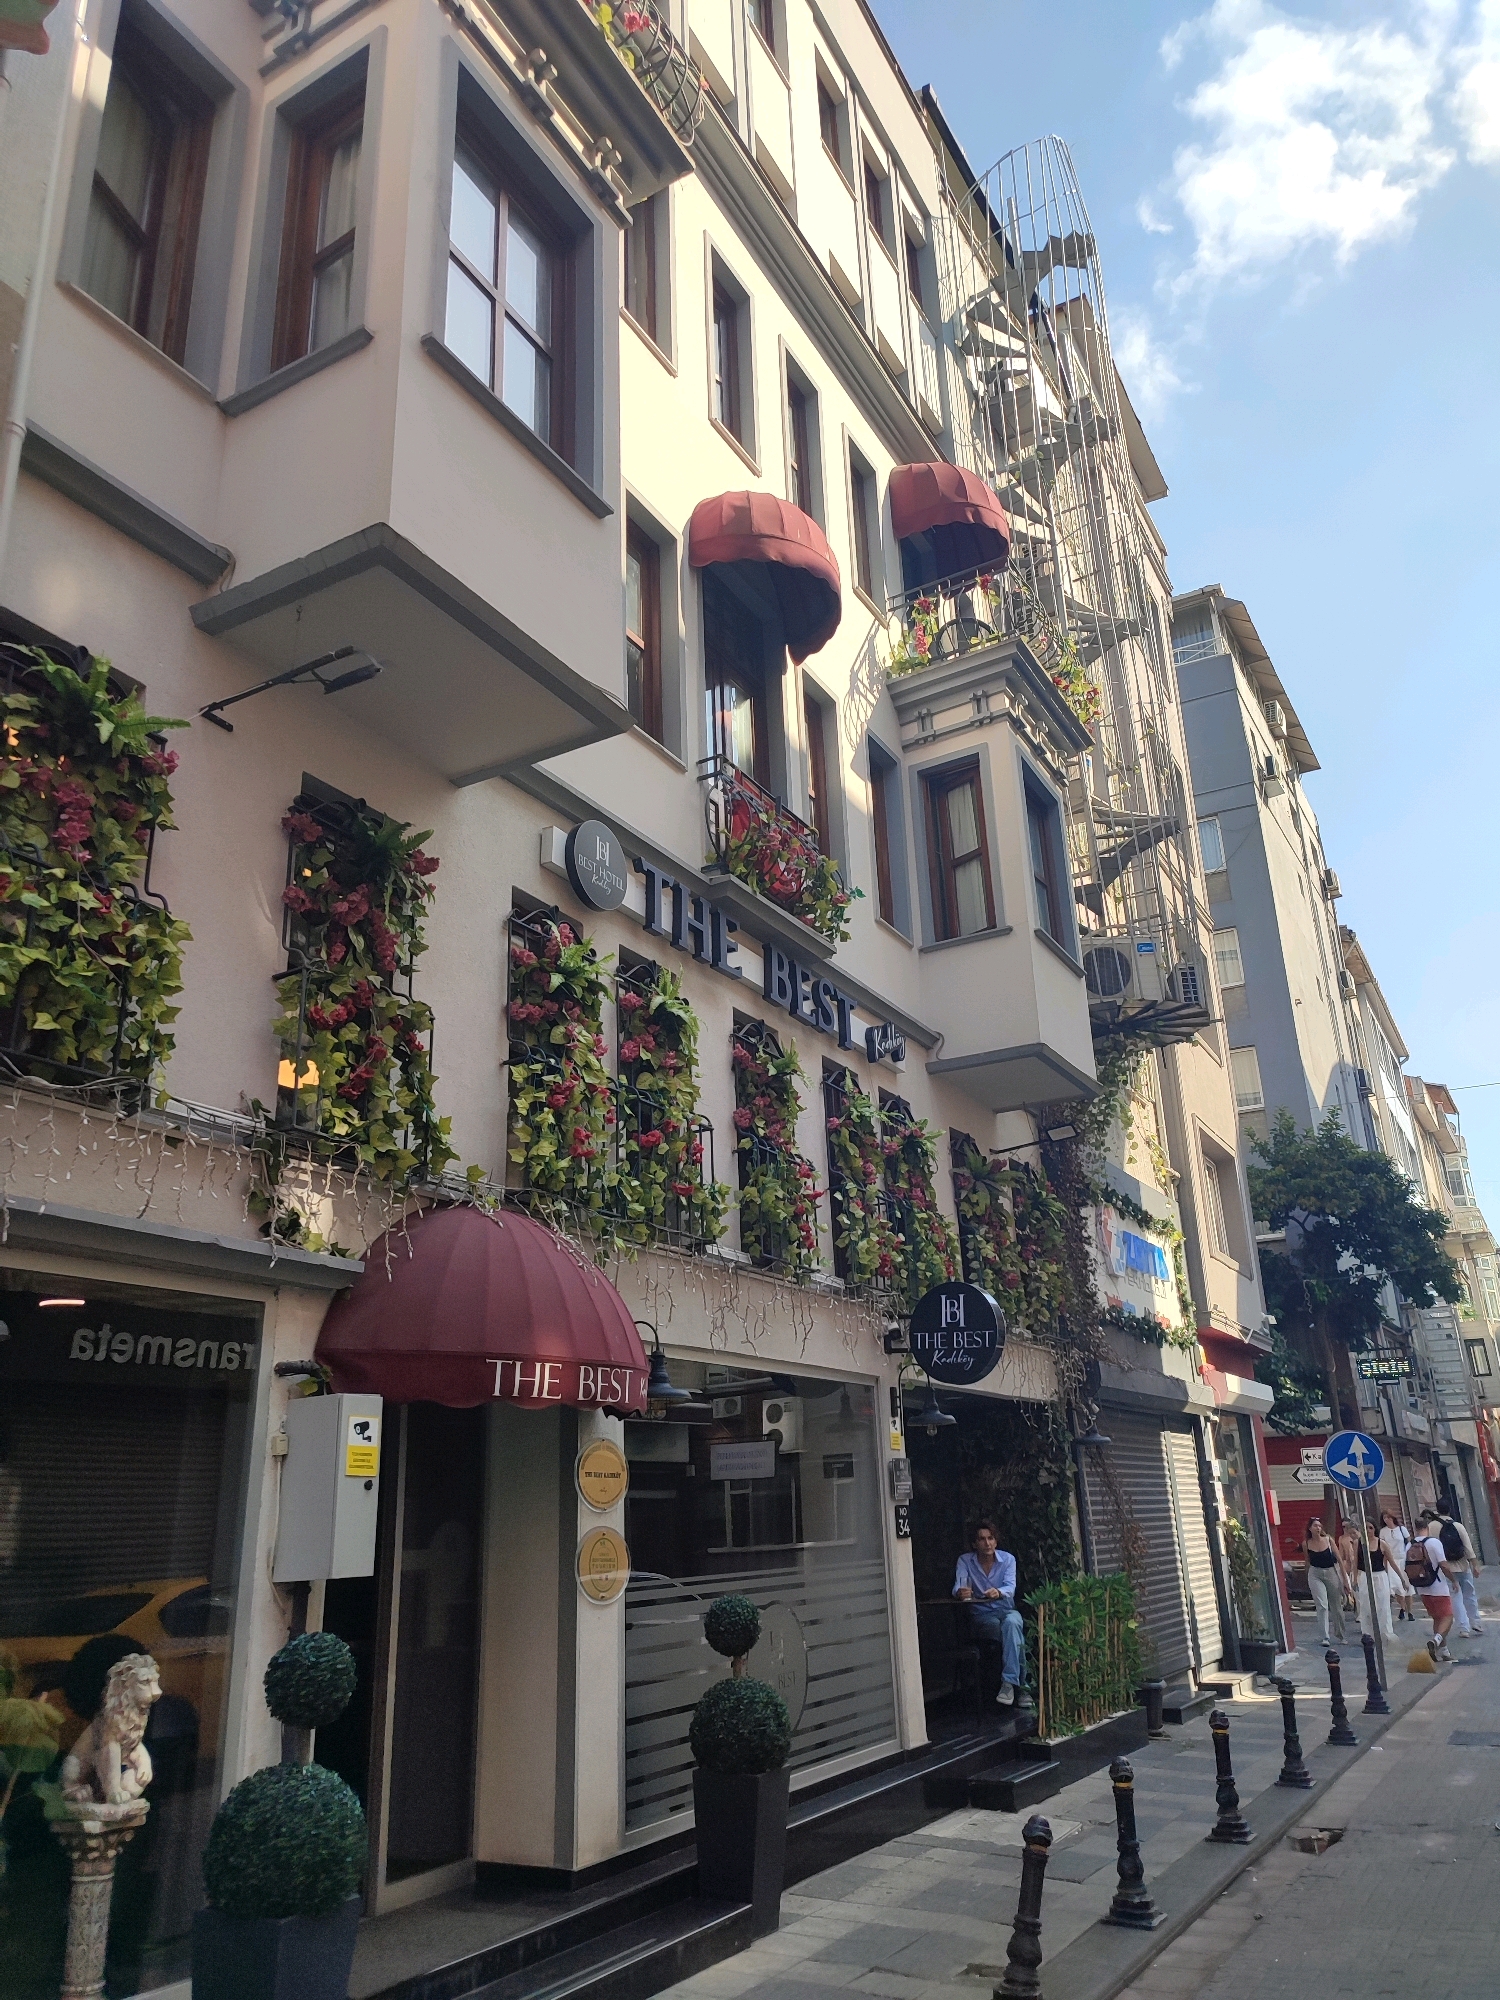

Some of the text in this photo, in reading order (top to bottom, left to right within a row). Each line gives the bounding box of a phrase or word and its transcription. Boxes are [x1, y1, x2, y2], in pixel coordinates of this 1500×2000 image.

[578, 853, 625, 892] BEST HOTEL
[632, 856, 743, 980] THE
[763, 943, 858, 1051] BEST
[913, 1330, 995, 1350] THE BEST
[485, 1358, 563, 1400] THE
[576, 1365, 634, 1404] BEST
[898, 1519, 911, 1536] 34
